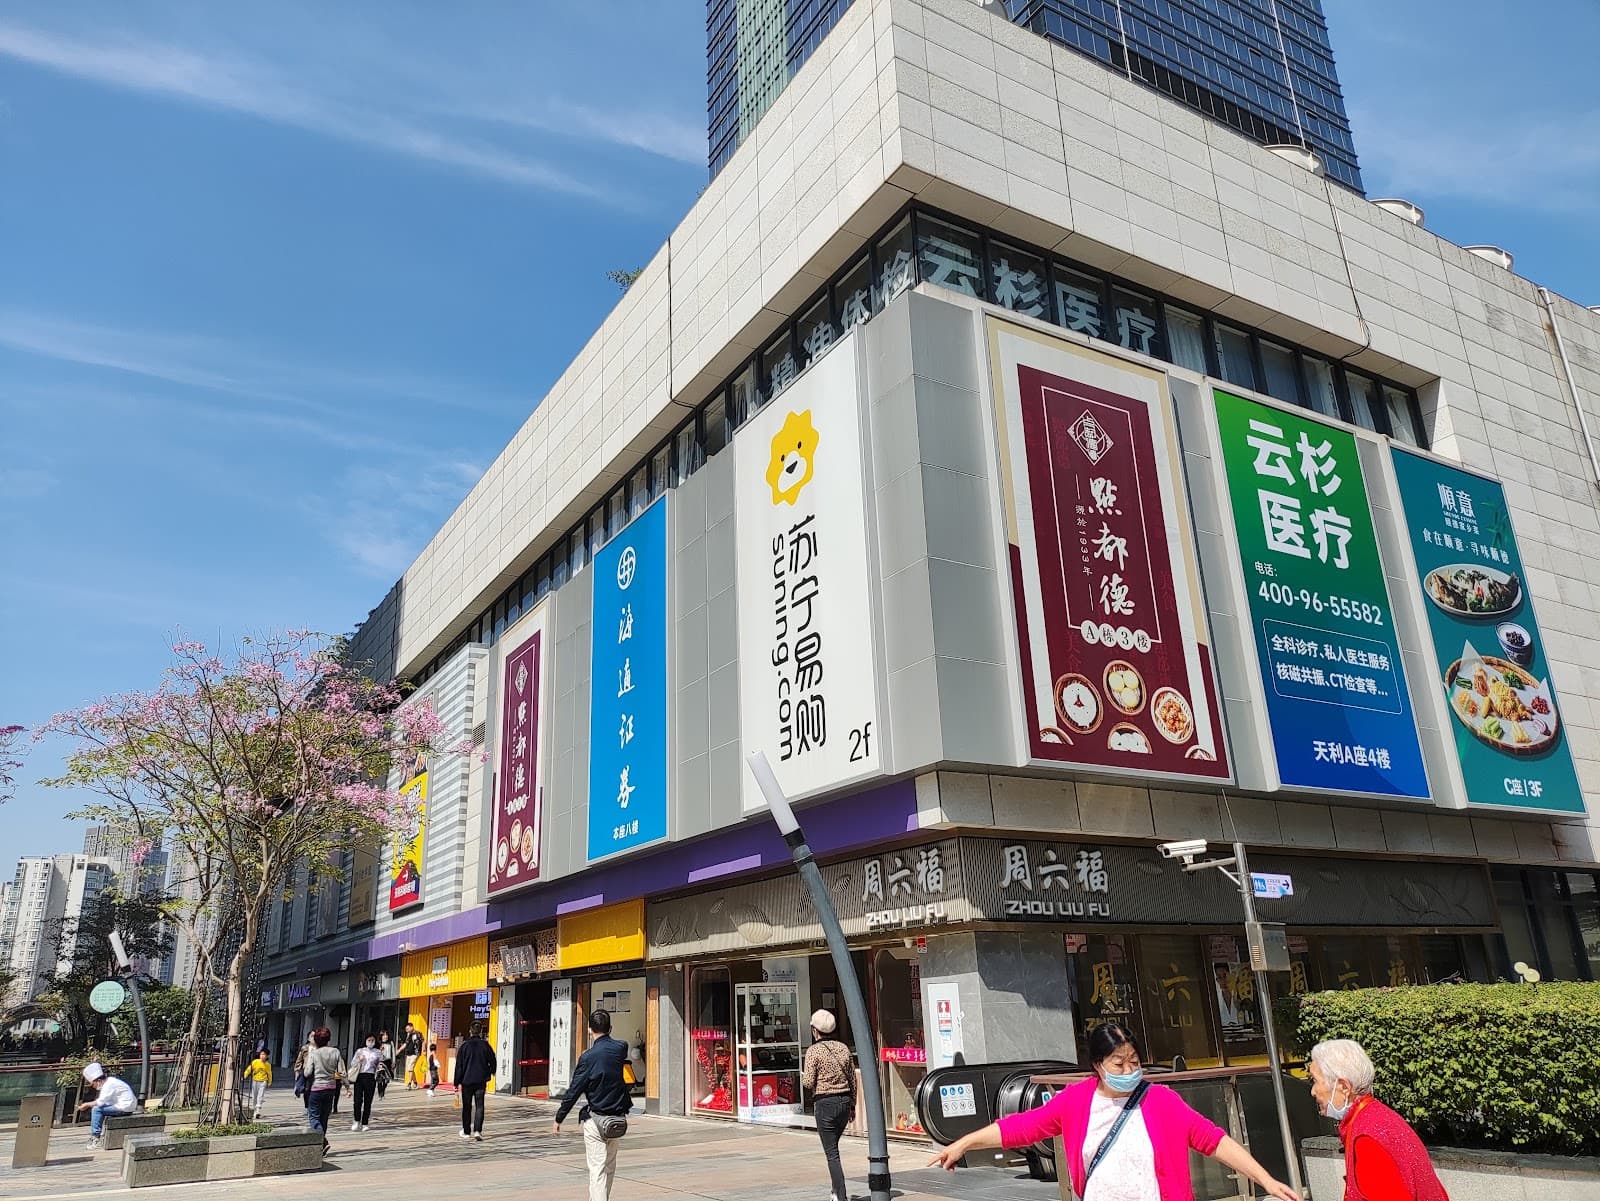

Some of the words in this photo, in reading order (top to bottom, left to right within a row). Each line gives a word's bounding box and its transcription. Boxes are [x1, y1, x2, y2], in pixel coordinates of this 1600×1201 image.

[924, 236, 1157, 356] 云杉医疗
[1246, 418, 1342, 496] 云杉
[1088, 477, 1135, 616] 點都德
[1257, 488, 1352, 569] 医疗
[1258, 581, 1383, 627] 400-96-55582
[772, 533, 793, 762] suning.com
[788, 513, 827, 756] 苏宁易购
[1084, 622, 1150, 650] A栋3楼
[1271, 634, 1390, 672] 全科诊疗、私人医生服务
[849, 721, 871, 763] 2f
[1313, 740, 1392, 770] 天利A座4楼
[861, 847, 944, 903] 周六福
[1000, 845, 1109, 894] 周六福
[865, 910, 900, 927] ZHOU
[902, 907, 924, 922] LIU
[925, 903, 945, 918] FU
[1006, 899, 1054, 915] ZHOU
[1059, 901, 1084, 916] LIU
[1088, 902, 1110, 917] FU
[1169, 1015, 1193, 1028] LIU
